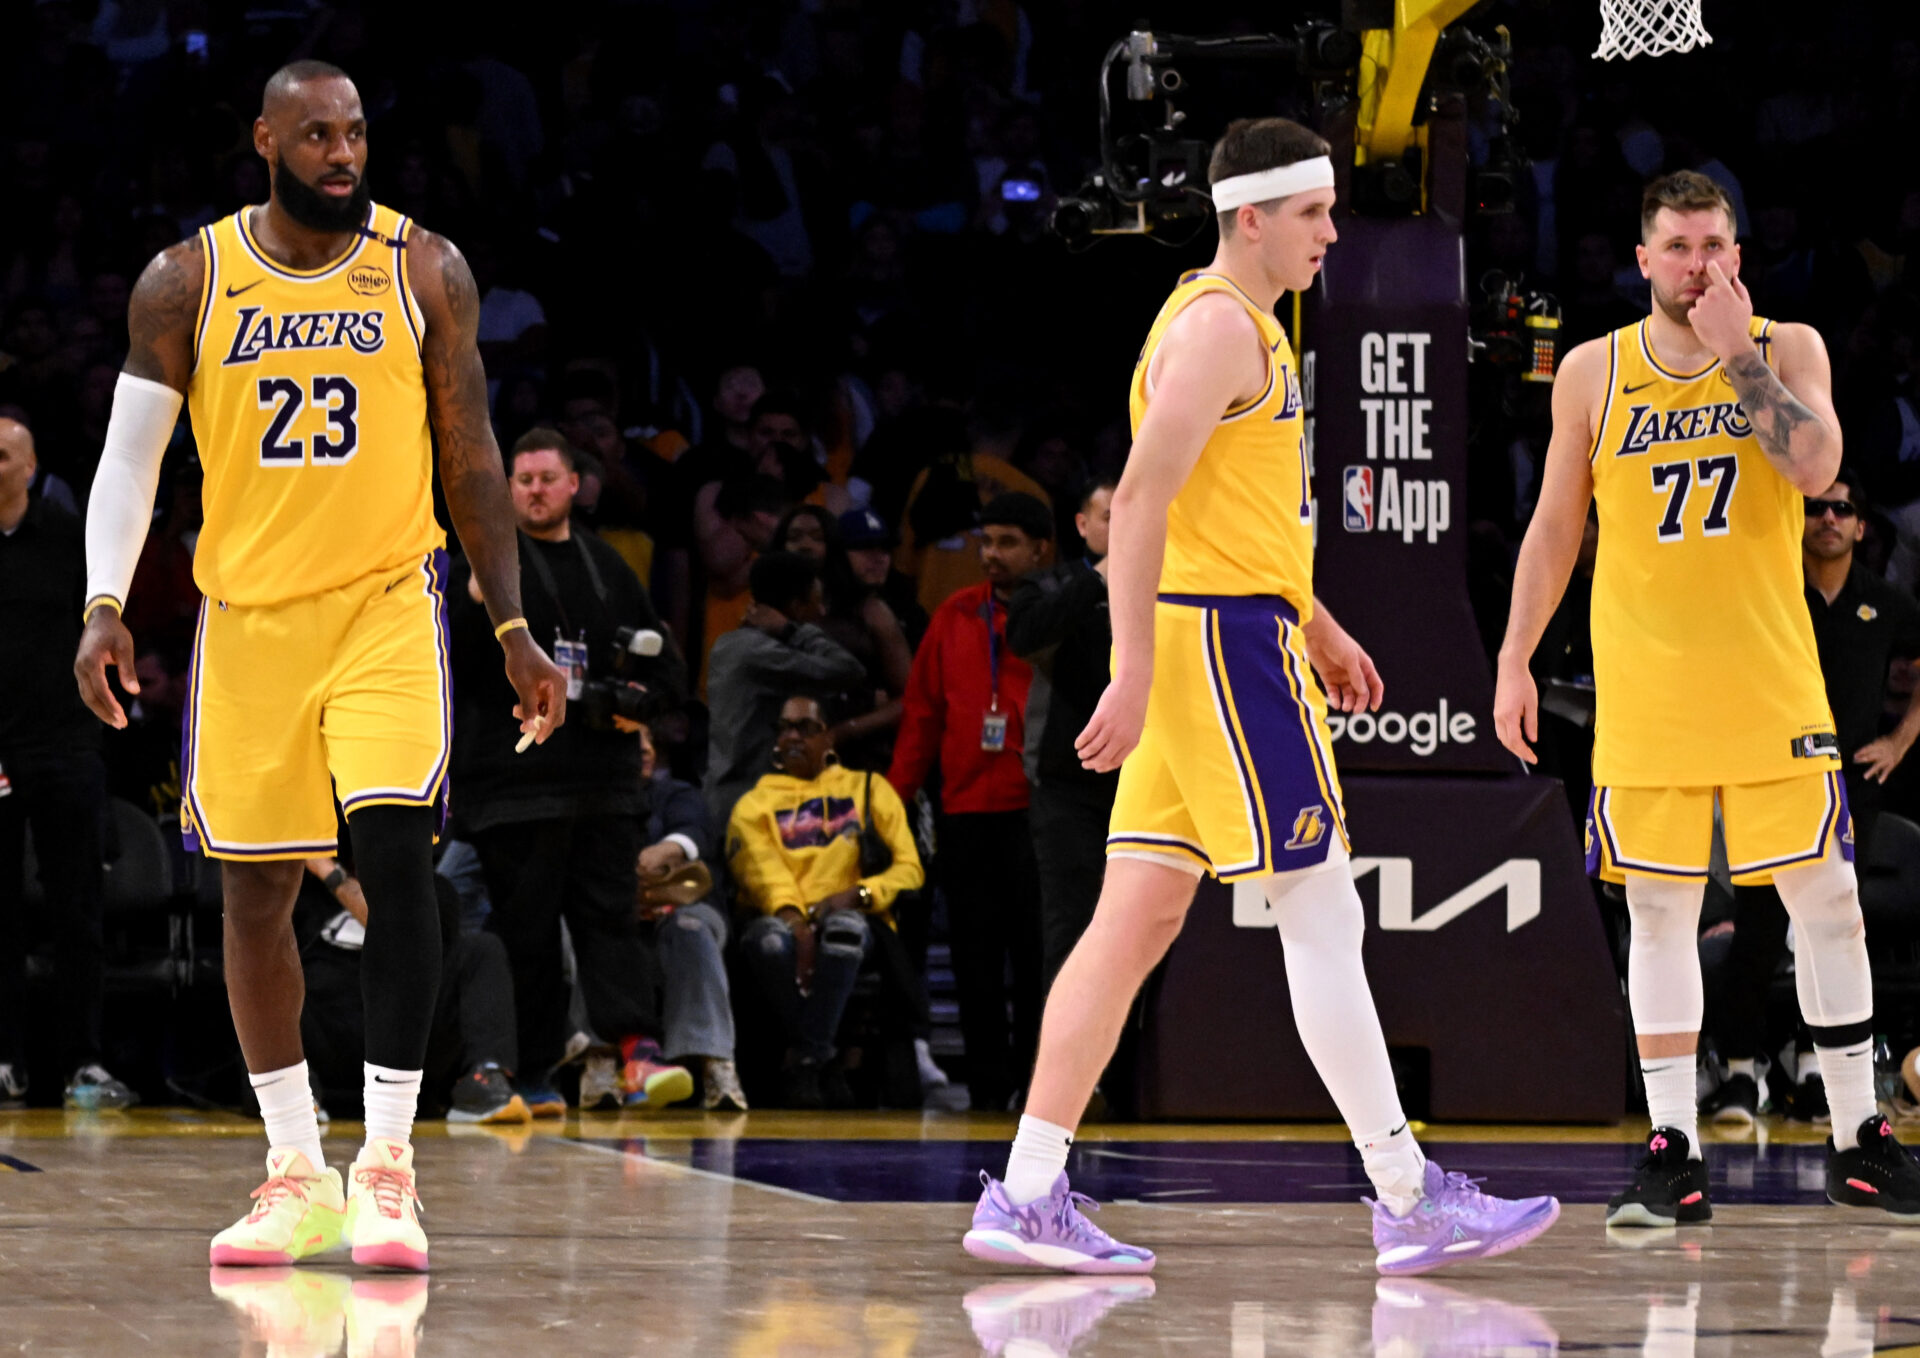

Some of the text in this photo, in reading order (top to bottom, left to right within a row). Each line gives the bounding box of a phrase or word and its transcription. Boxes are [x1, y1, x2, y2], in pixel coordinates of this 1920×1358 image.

[351, 273, 388, 289] bibigo
[221, 305, 385, 367] LAKERS
[1360, 331, 1432, 393] GET
[257, 374, 359, 468] 23
[1360, 399, 1433, 460] THE
[1615, 403, 1753, 458] LAKERS
[1377, 466, 1451, 544] App
[1651, 453, 1740, 543] 77
